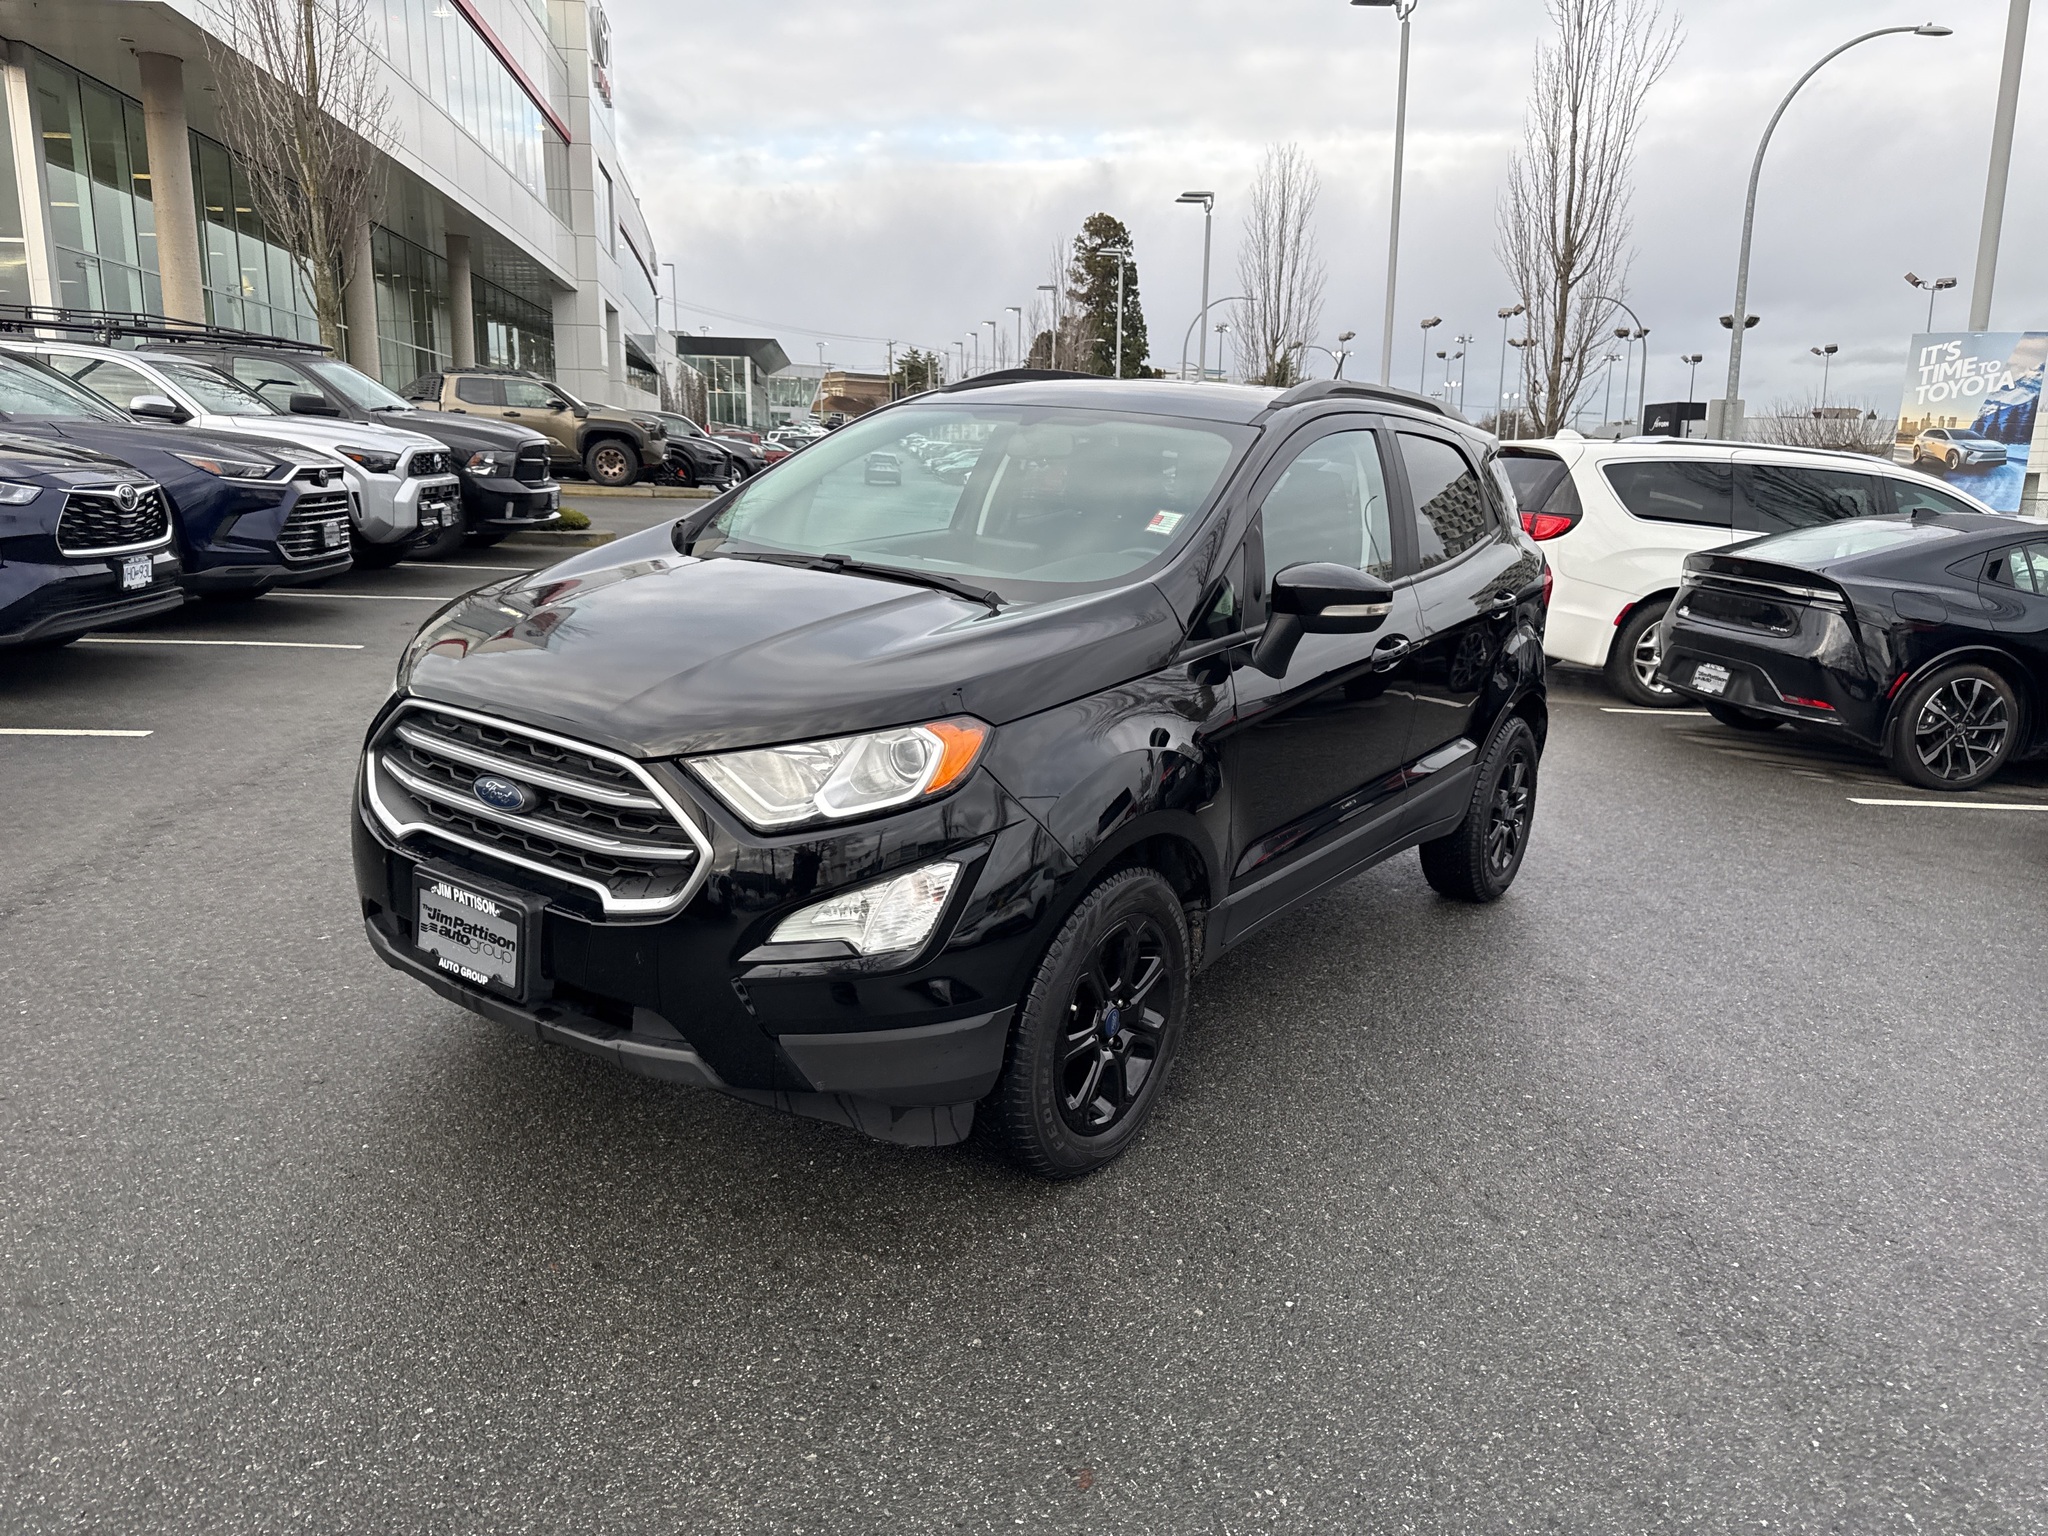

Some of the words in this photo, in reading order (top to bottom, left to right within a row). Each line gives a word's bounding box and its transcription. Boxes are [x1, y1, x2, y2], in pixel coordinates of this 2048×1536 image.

[1919, 340, 1962, 367] IT'S
[1918, 356, 1978, 385] TIME
[1979, 360, 2001, 375] TO
[1916, 370, 2015, 405] TOYOTA
[422, 903, 432, 912] The
[437, 883, 452, 900] JIM
[453, 888, 496, 914] PATTISON
[438, 957, 459, 974] AUTO
[460, 967, 489, 985] GROUP
